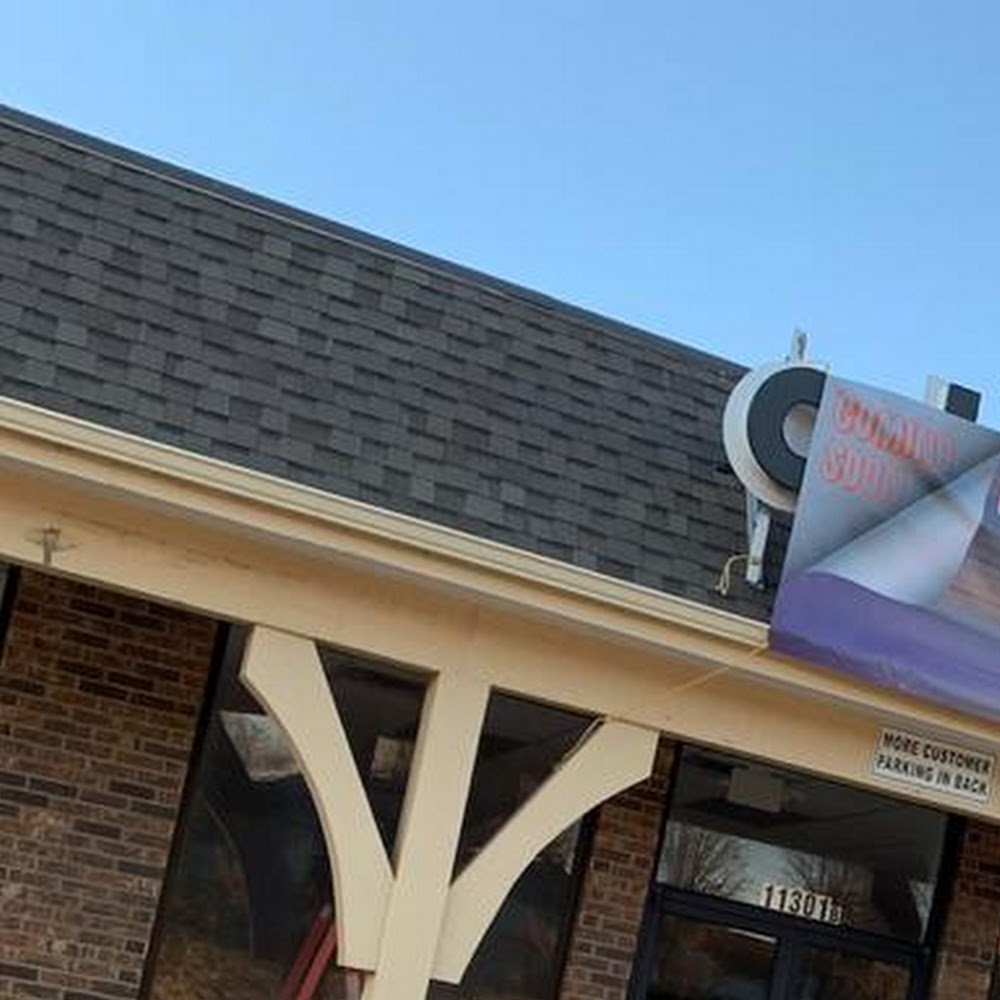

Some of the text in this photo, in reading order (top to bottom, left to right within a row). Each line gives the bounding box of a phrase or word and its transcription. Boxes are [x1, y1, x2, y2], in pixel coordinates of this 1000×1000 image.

[882, 731, 991, 775] MORE CUSTOMER
[876, 754, 988, 796] PARKING IN BACK
